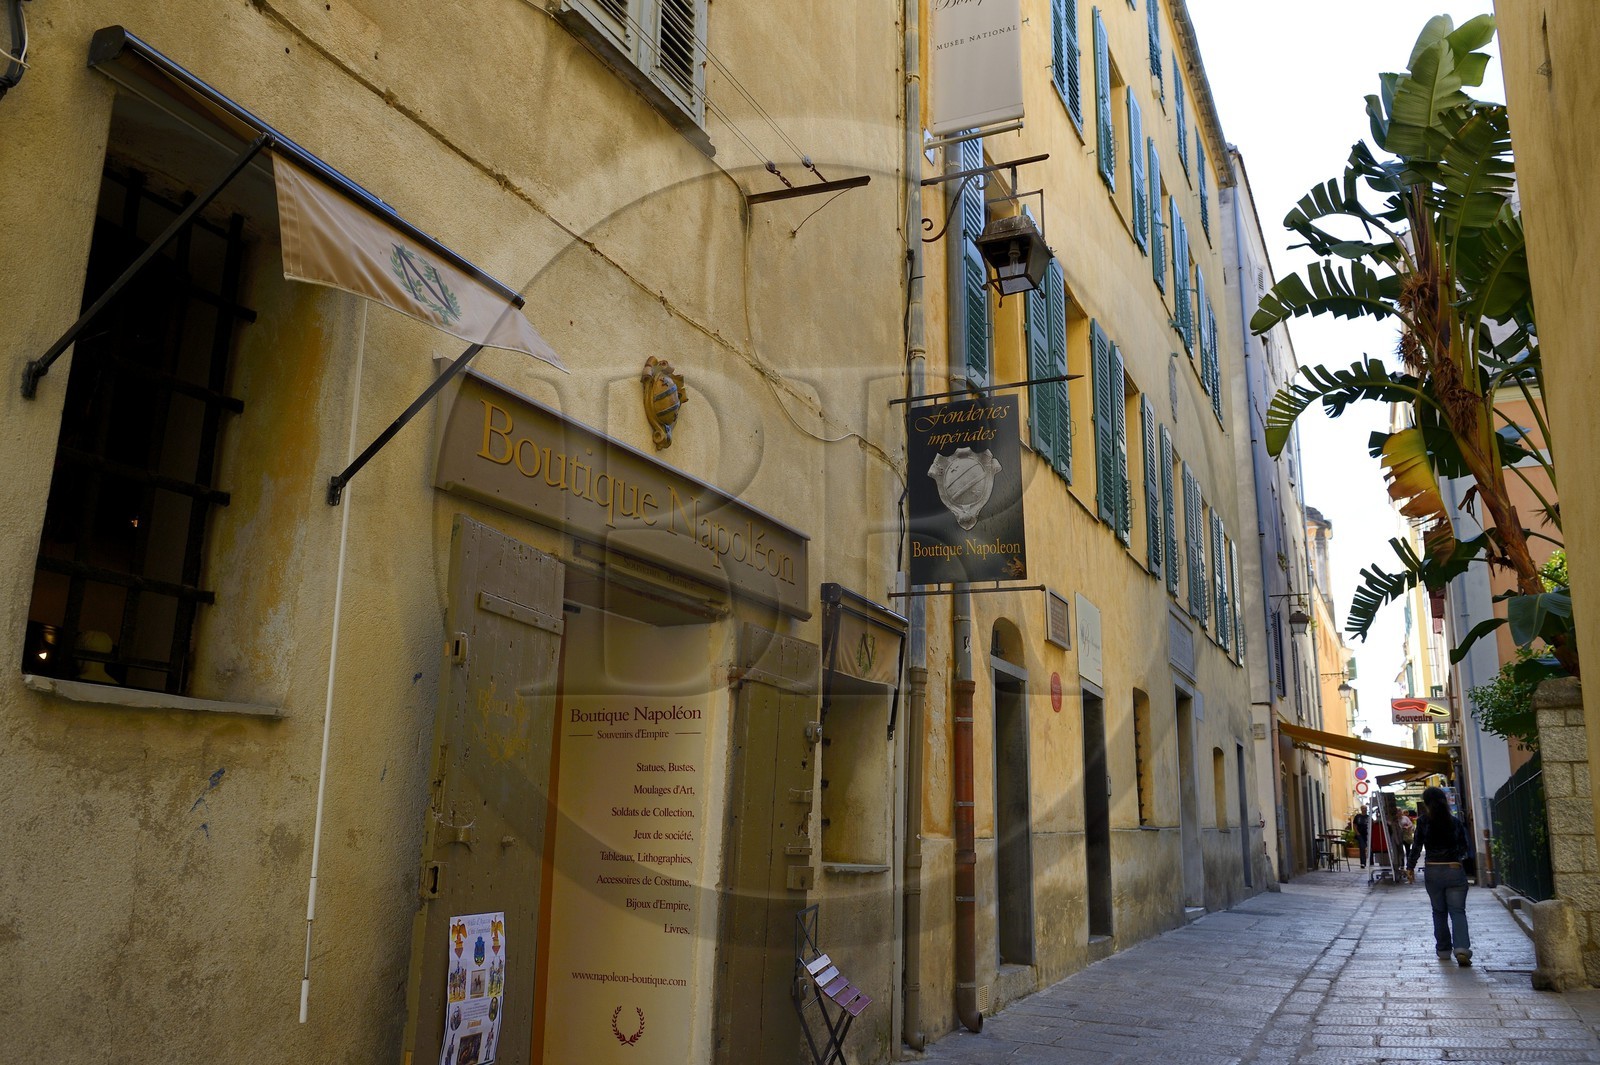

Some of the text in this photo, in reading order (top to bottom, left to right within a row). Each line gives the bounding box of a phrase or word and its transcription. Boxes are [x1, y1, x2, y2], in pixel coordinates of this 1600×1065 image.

[969, 24, 1018, 42] NATIONAL
[914, 402, 1010, 432] Fonderies
[927, 426, 997, 450] impériales
[477, 399, 796, 586] Boutique Napoléon
[913, 538, 1020, 561] Boutique Napoleon
[570, 705, 702, 726] Boutique Napoléon
[1395, 713, 1434, 723] Souvenirs
[597, 728, 670, 740] Souvenirs d'Empire
[636, 762, 696, 773] Statues, Bustes,
[633, 785, 695, 797] Moulages d'Art,
[611, 807, 695, 818] Soldats de Collection,
[633, 829, 694, 841] Jeux de société,
[600, 850, 693, 866] Tableaux, Lithographies,
[596, 874, 692, 888] Accessoires de Costume,
[626, 898, 691, 912] Bijoux d'Empire,
[664, 923, 690, 935] Livres.
[571, 971, 687, 988] www.napoleon-boutique.com
